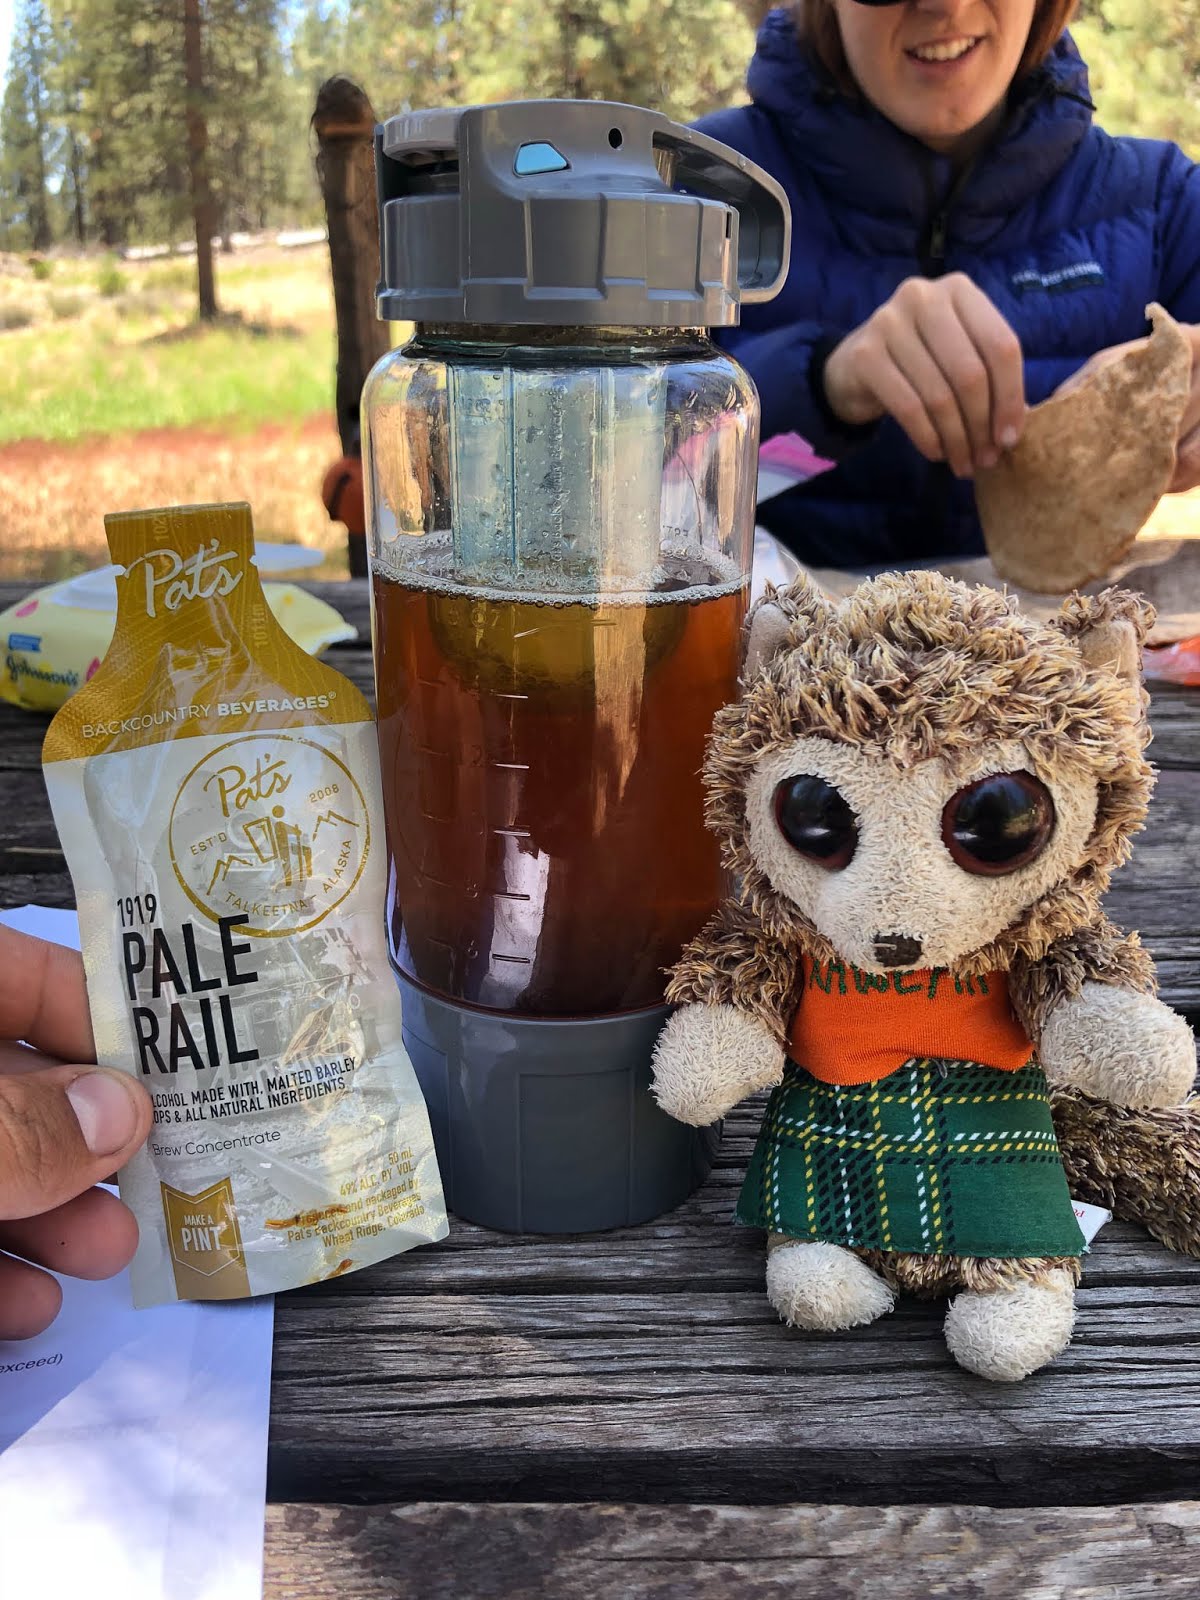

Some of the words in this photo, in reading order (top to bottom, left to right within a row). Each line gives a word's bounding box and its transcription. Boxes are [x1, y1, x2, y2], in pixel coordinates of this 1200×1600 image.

[123, 537, 244, 618] Pat's
[82, 704, 210, 738] BACKCOUNTRY
[203, 753, 293, 818] Pat's
[309, 784, 340, 803] 2008
[190, 831, 228, 856] EST'D
[225, 891, 308, 917] TALKEETNA
[322, 839, 352, 894] ALASKA
[117, 893, 157, 927] 1919
[122, 914, 259, 1001] PALE
[132, 994, 260, 1075] RAIL
[151, 1092, 187, 1108] LCOHOL
[191, 1086, 226, 1105] MADE
[267, 1069, 313, 1092] MALTED
[315, 1056, 356, 1080] BARLEY
[153, 1109, 171, 1124] OPS
[174, 1110, 182, 1123] &
[186, 1106, 208, 1122] ALL
[210, 1096, 265, 1119] NATURAL
[267, 1076, 346, 1108] INGREDIENTS
[152, 1143, 182, 1156] Brew
[185, 1130, 281, 1155] Concentrate
[388, 1151, 399, 1165] 50
[382, 1167, 393, 1182] BY
[396, 1160, 417, 1176] VOL.
[366, 1184, 407, 1209] packaged
[408, 1178, 420, 1194] by
[184, 1214, 206, 1226] MAKE
[207, 1214, 215, 1225] A
[287, 1225, 312, 1243] Pat's
[182, 1226, 221, 1251] PINT
[321, 1229, 354, 1248] Wheat
